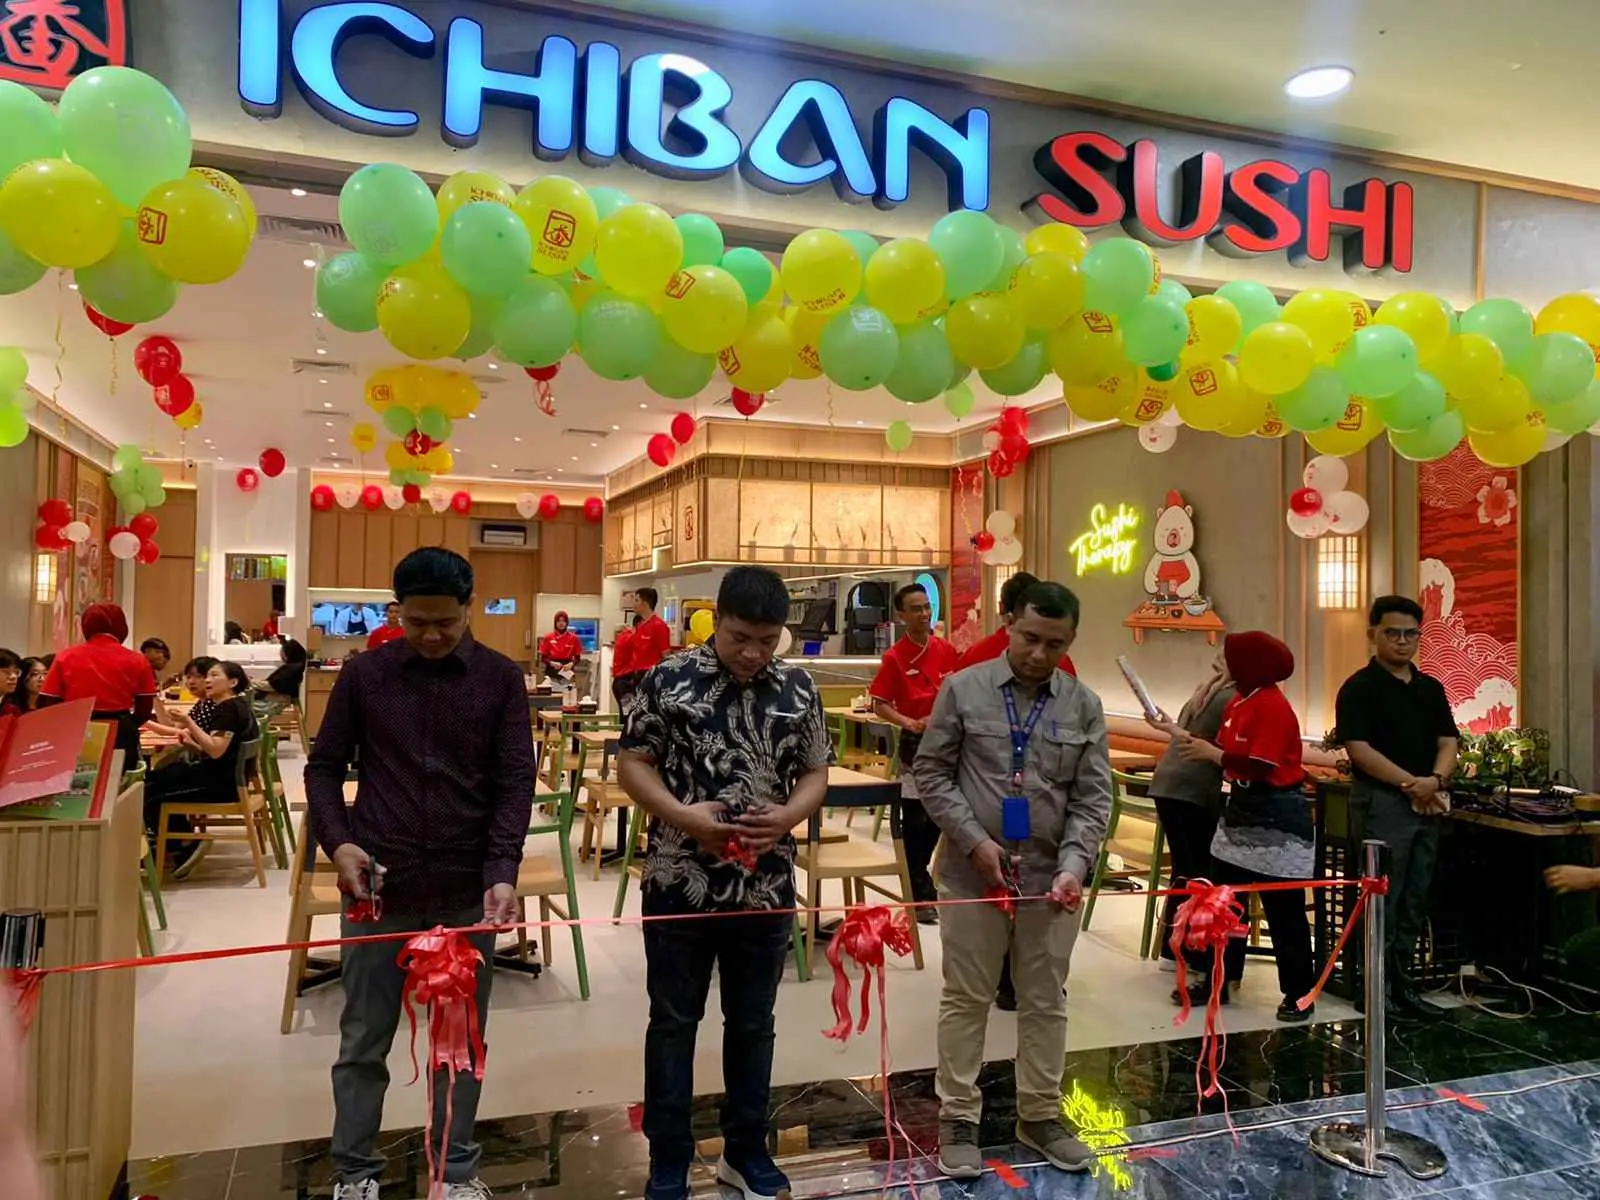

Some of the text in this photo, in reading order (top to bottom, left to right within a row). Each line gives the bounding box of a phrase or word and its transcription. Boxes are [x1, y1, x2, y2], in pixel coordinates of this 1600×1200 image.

[237, 0, 1415, 274] ICHIBAN SUSHI
[1090, 502, 1139, 550] Sushi
[1068, 532, 1137, 577] Therapy
